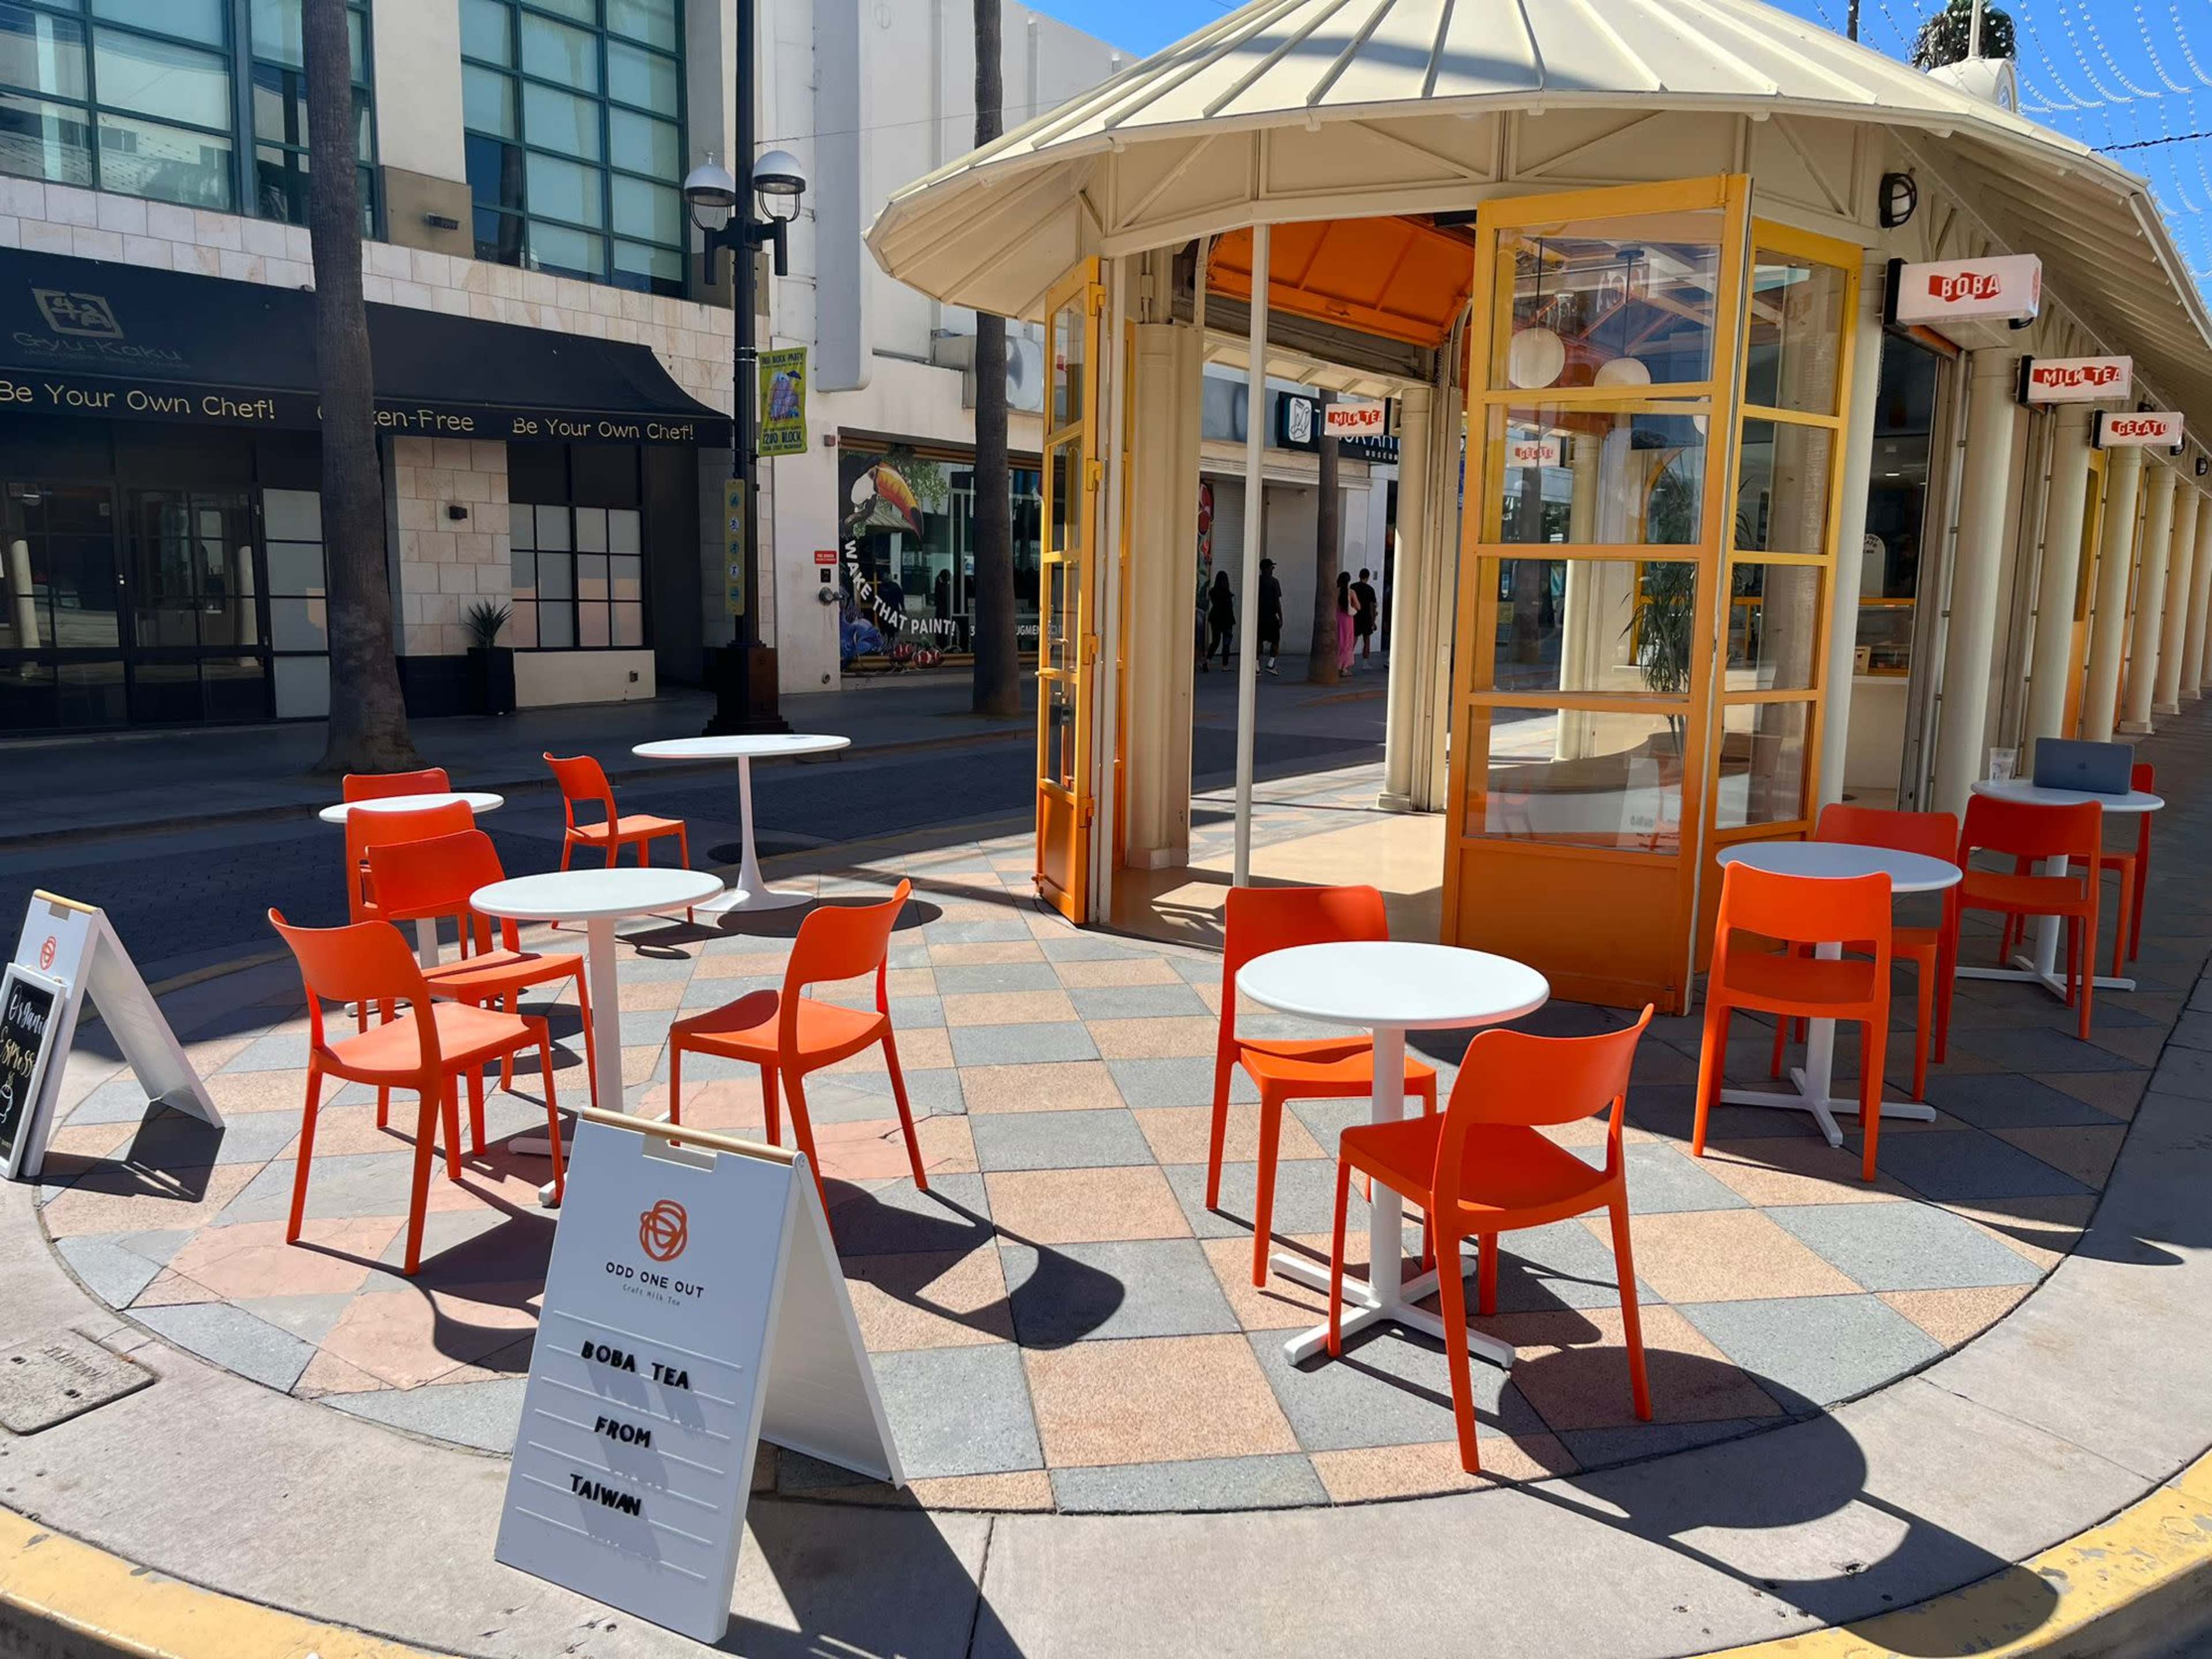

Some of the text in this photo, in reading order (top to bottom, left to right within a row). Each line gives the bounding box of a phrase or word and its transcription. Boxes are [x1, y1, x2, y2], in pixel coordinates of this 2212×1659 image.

[1941, 274, 2000, 297] BOBA
[13, 332, 183, 361] Gyu-Kaku
[2043, 368, 2122, 384] MILK TEA
[0, 380, 275, 419] Be Your Own Chef!
[513, 418, 694, 440] Be Your Own Chef!
[1334, 411, 1382, 425] MILK TEA
[2117, 422, 2168, 433] GELATO
[845, 540, 956, 637] WAKE THAT PAINT!
[605, 1262, 704, 1298] ODD ONE OUT
[623, 1283, 680, 1306] Craft Milk Tea
[581, 1340, 690, 1390] BOBA TEA
[593, 1415, 652, 1448] FROM
[570, 1472, 642, 1516] TAIWAN
